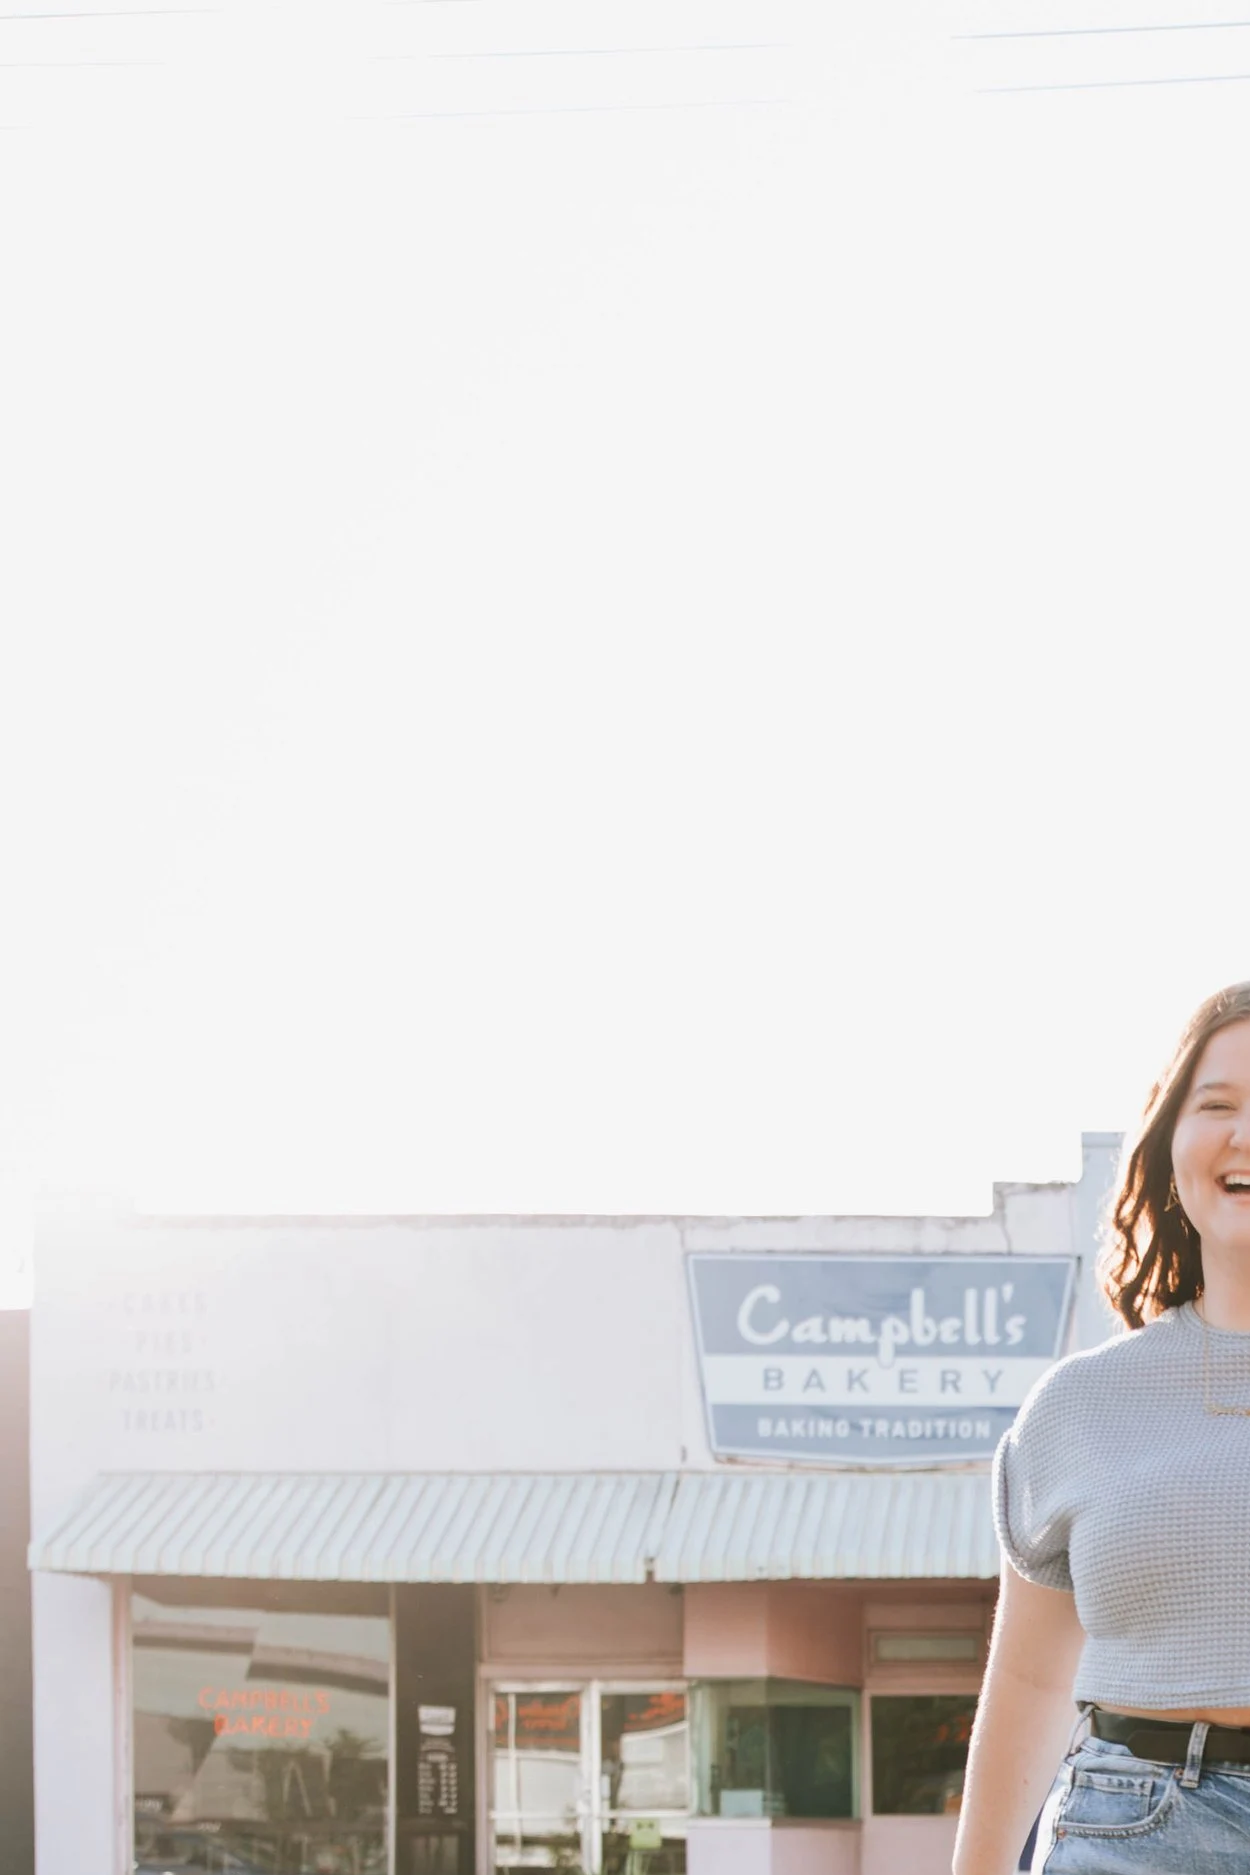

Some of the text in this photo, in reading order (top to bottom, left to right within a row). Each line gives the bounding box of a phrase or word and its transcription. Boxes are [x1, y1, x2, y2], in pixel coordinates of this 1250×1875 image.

[736, 1284, 1027, 1369] Campbell's
[762, 1367, 1004, 1394] BAKERY
[757, 1417, 849, 1438] BAKING
[212, 1713, 314, 1739] BAKERY
